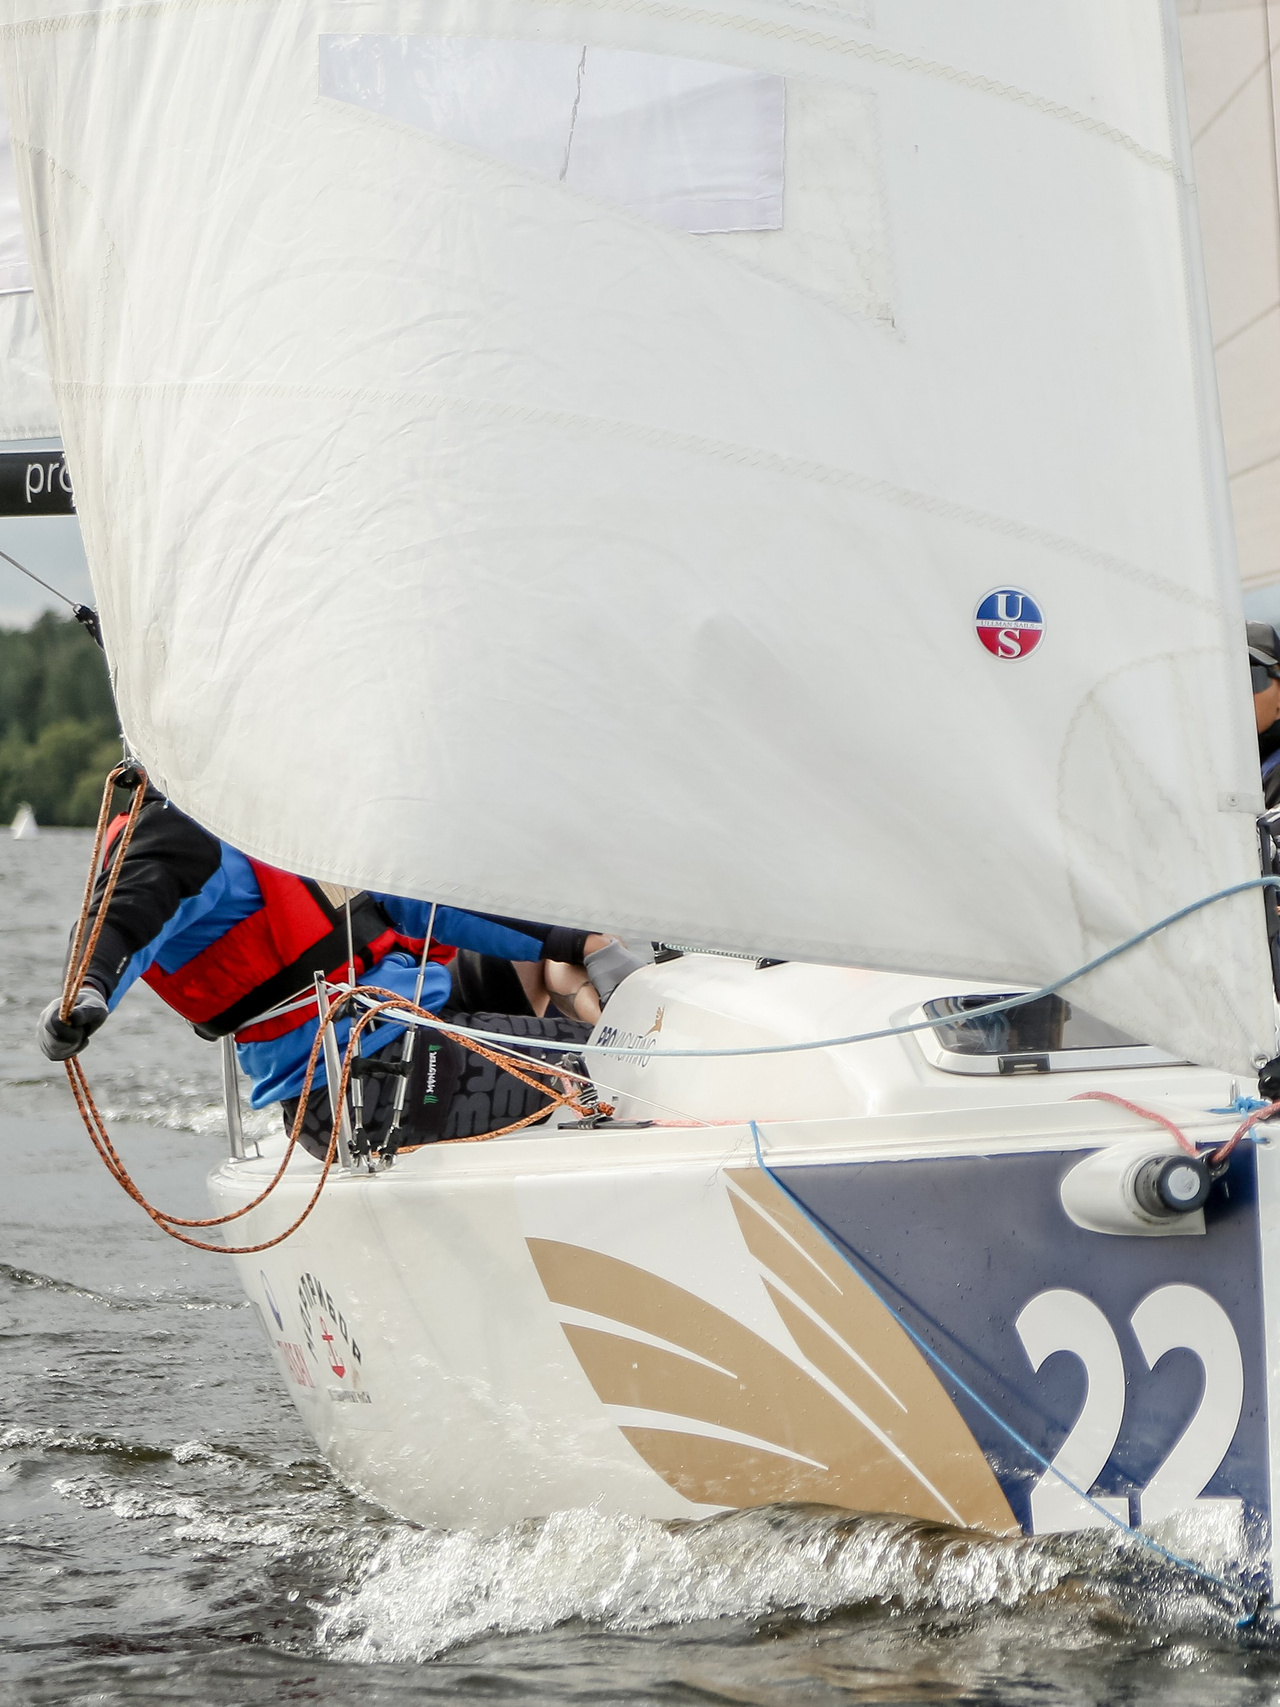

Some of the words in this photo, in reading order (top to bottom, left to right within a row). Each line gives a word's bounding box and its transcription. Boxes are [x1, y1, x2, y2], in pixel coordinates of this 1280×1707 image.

[995, 593, 1026, 621] U
[997, 628, 1022, 658] S
[426, 1051, 437, 1093] MONSTER
[1015, 1284, 1245, 1535] 22
